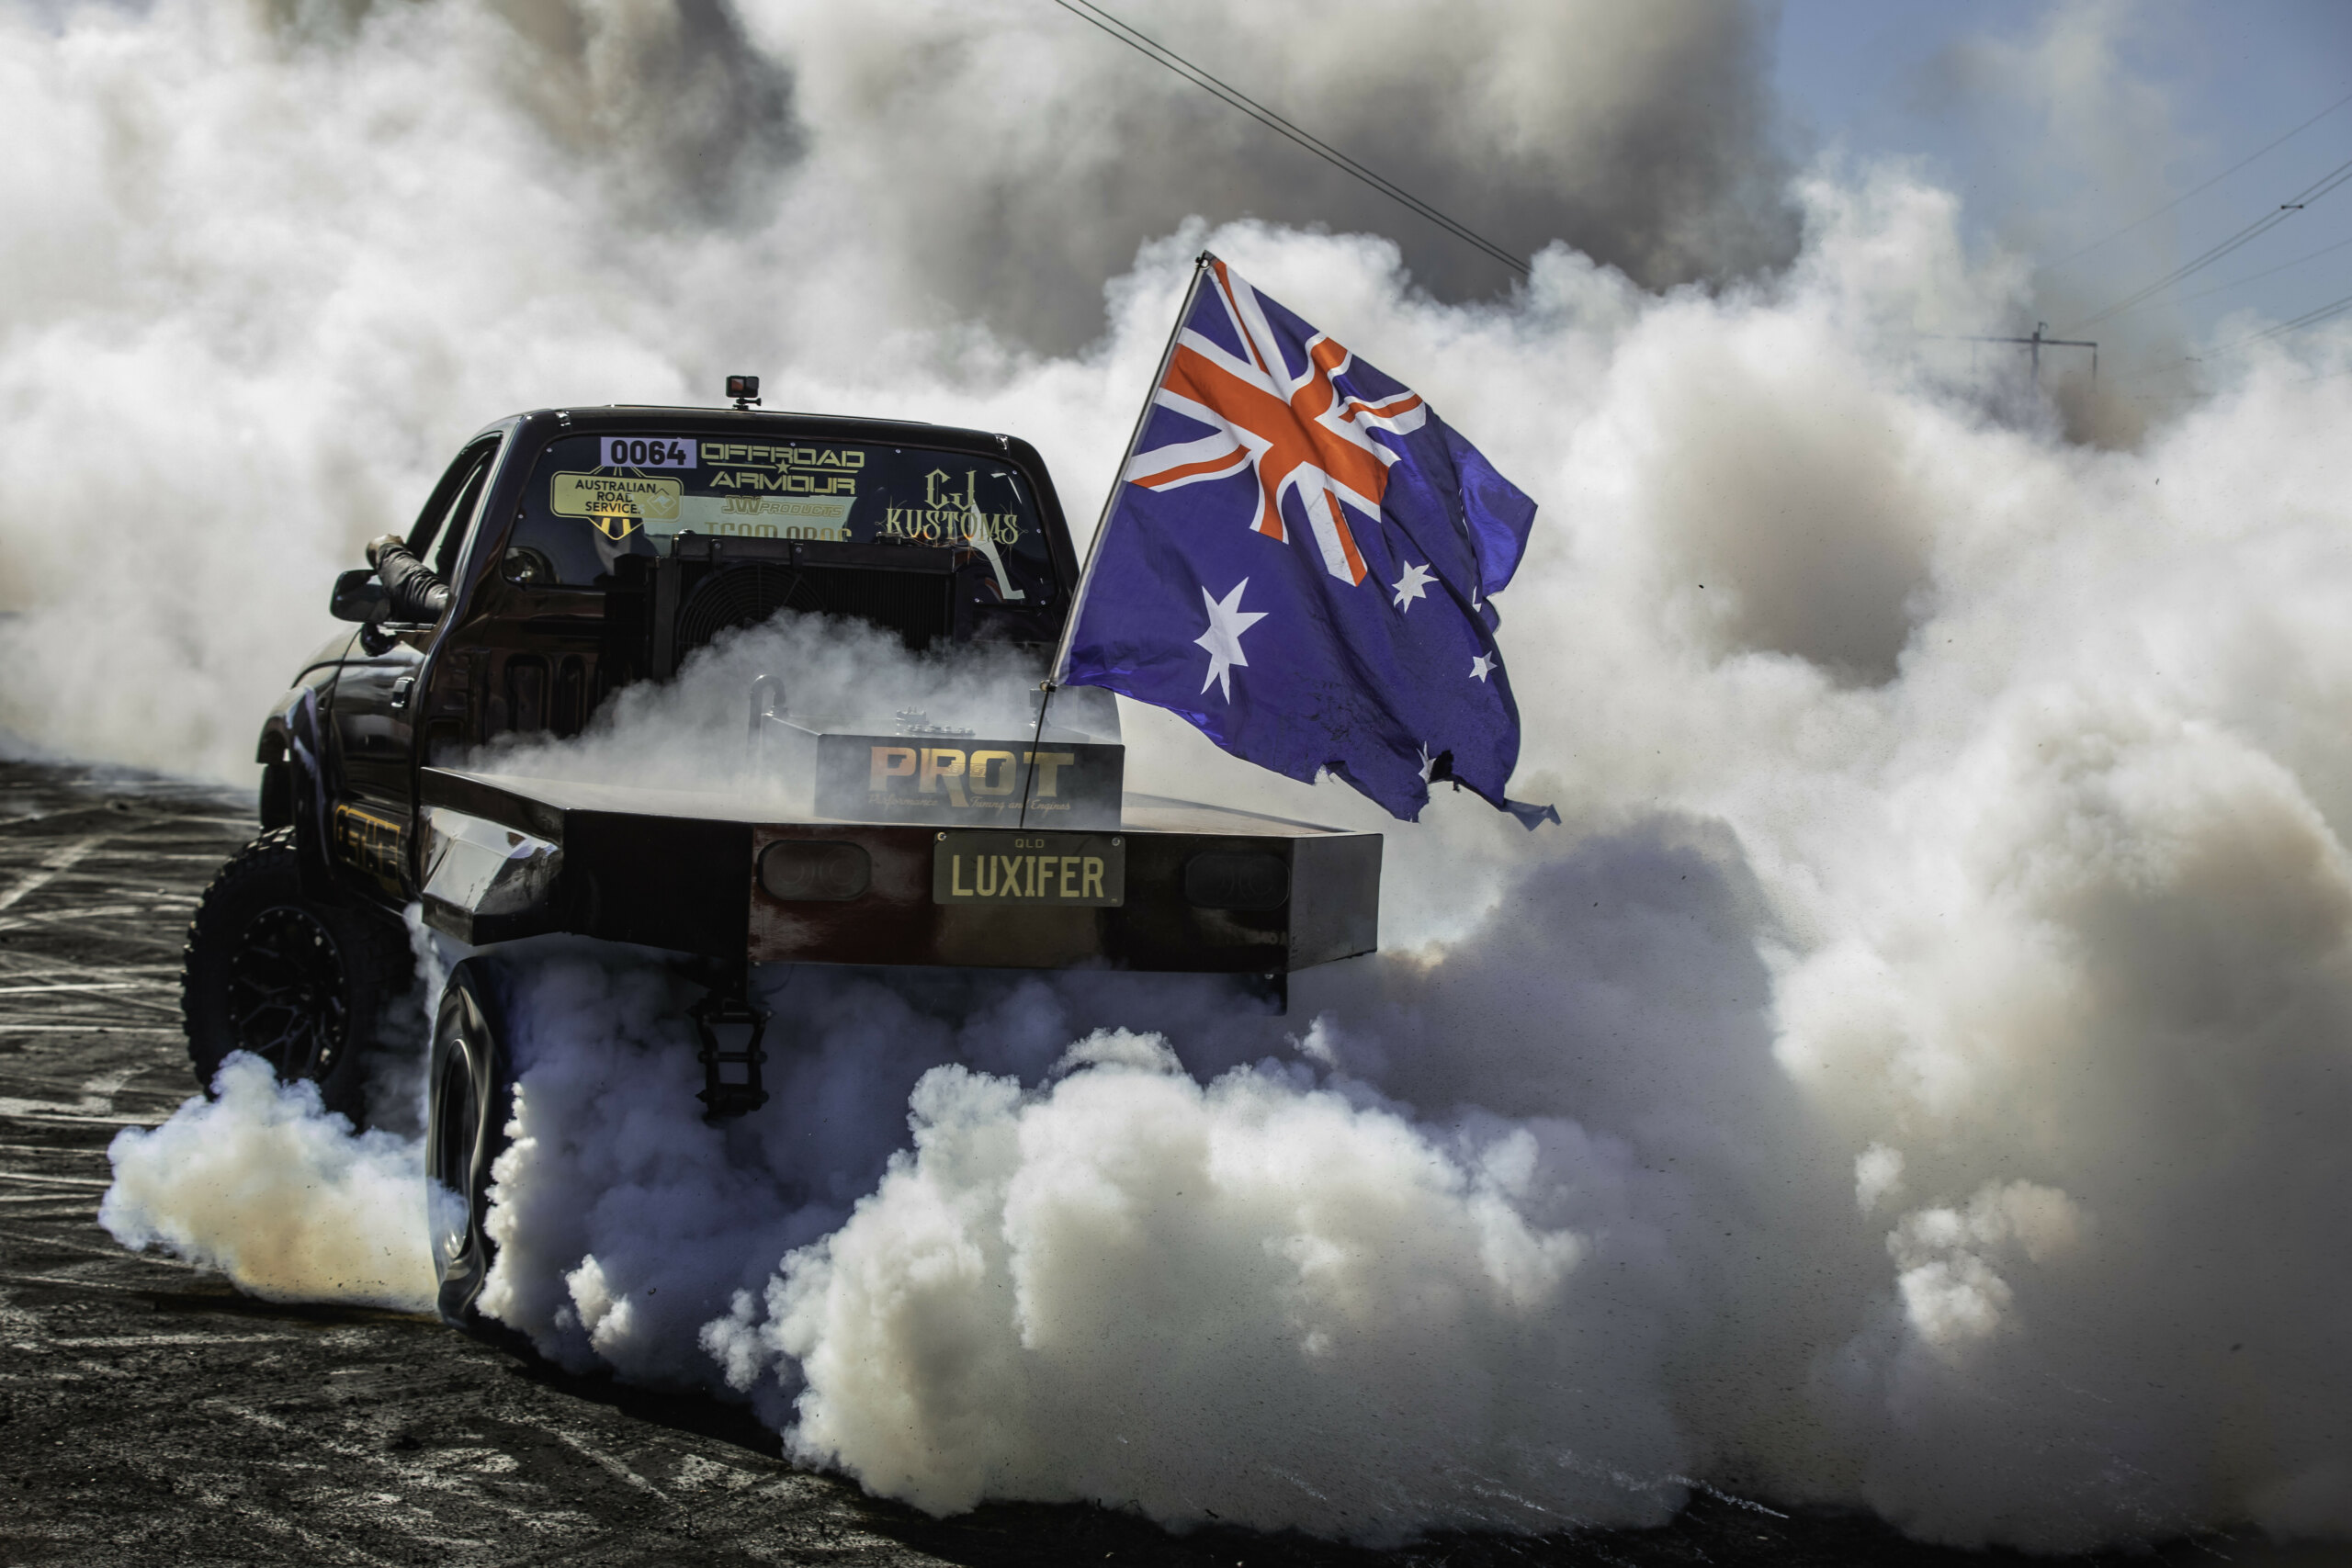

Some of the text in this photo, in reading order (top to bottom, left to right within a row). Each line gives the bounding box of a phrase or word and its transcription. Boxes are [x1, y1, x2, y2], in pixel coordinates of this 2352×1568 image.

[611, 440, 686, 466] 0064
[701, 443, 865, 468] OFFROAD
[575, 479, 656, 493] AUSTRALIAN
[709, 471, 855, 494] ARMOUR
[597, 491, 634, 503] ROAD
[887, 508, 1019, 545] KUSTOMS
[869, 747, 1074, 807] PROT
[1014, 838, 1045, 849] QLD
[952, 855, 1104, 897] LUXIFER
